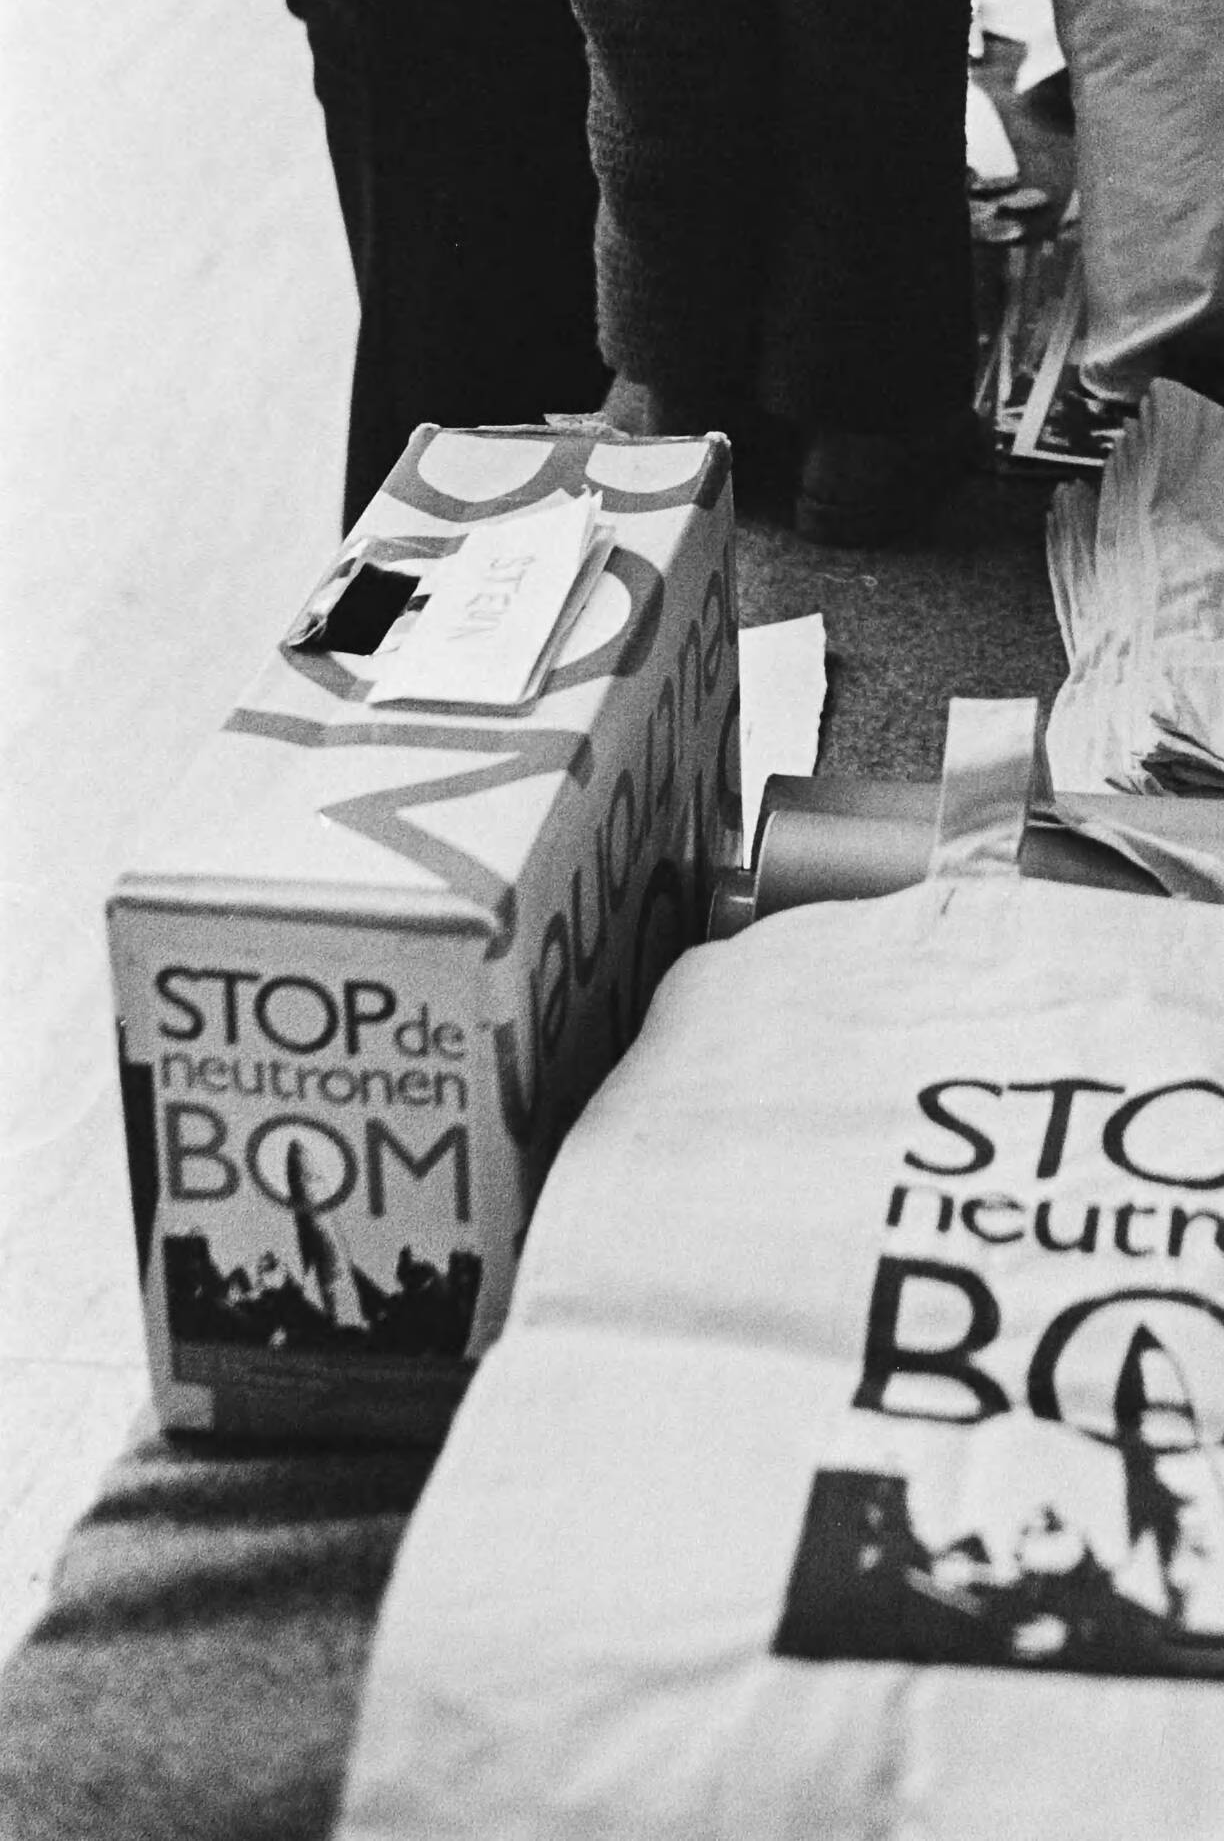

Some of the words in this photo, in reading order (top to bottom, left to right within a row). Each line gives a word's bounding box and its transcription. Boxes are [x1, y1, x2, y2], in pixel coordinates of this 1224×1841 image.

[154, 966, 398, 1055] STOP
[395, 1000, 467, 1059] de
[161, 1049, 469, 1109] neutronen
[163, 1100, 471, 1223] BOM
